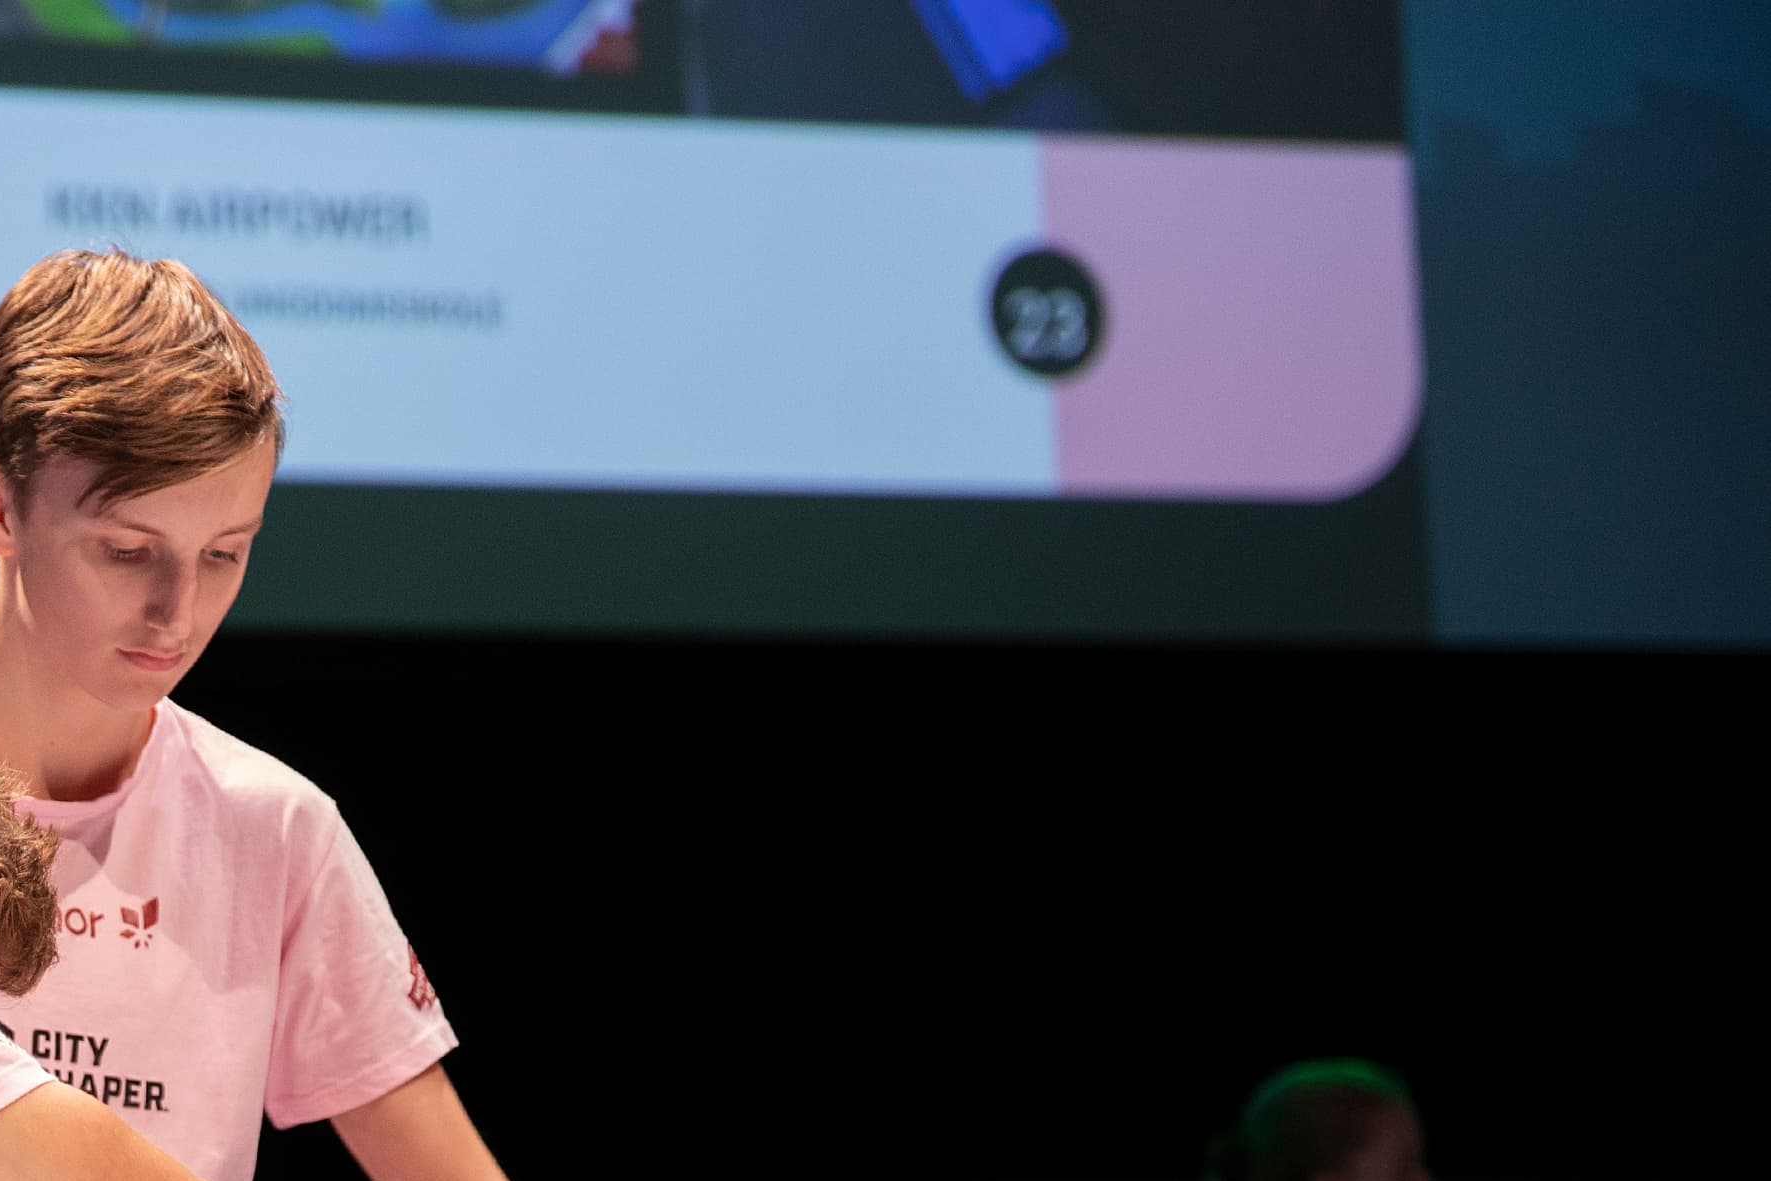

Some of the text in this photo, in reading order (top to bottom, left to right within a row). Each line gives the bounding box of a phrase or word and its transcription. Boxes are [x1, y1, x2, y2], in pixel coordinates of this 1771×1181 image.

[166, 184, 430, 240] AIRPOWER
[1003, 286, 1087, 358] 23
[32, 1029, 109, 1066] CITY
[43, 1066, 166, 1111] HAPER
